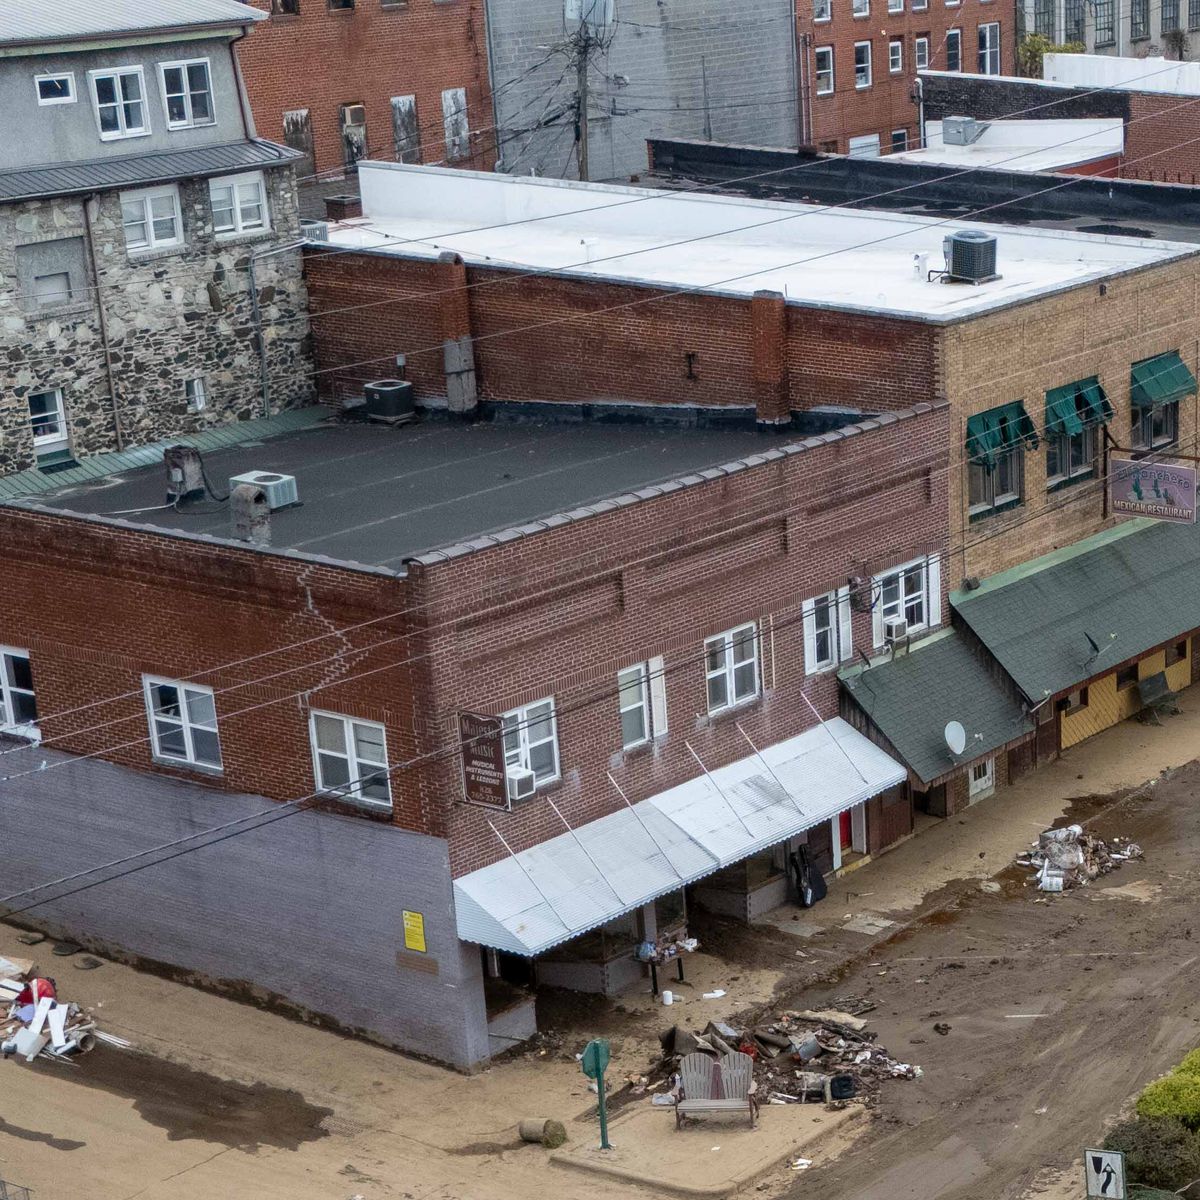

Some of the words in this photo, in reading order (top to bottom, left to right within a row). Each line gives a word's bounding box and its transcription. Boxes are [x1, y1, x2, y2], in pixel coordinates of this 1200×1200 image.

[1113, 500, 1147, 513] MEXICAN
[1147, 504, 1193, 519] RESTAURANT
[471, 760, 495, 770] MUSICAL
[465, 766, 504, 780] INSTRUMENTS
